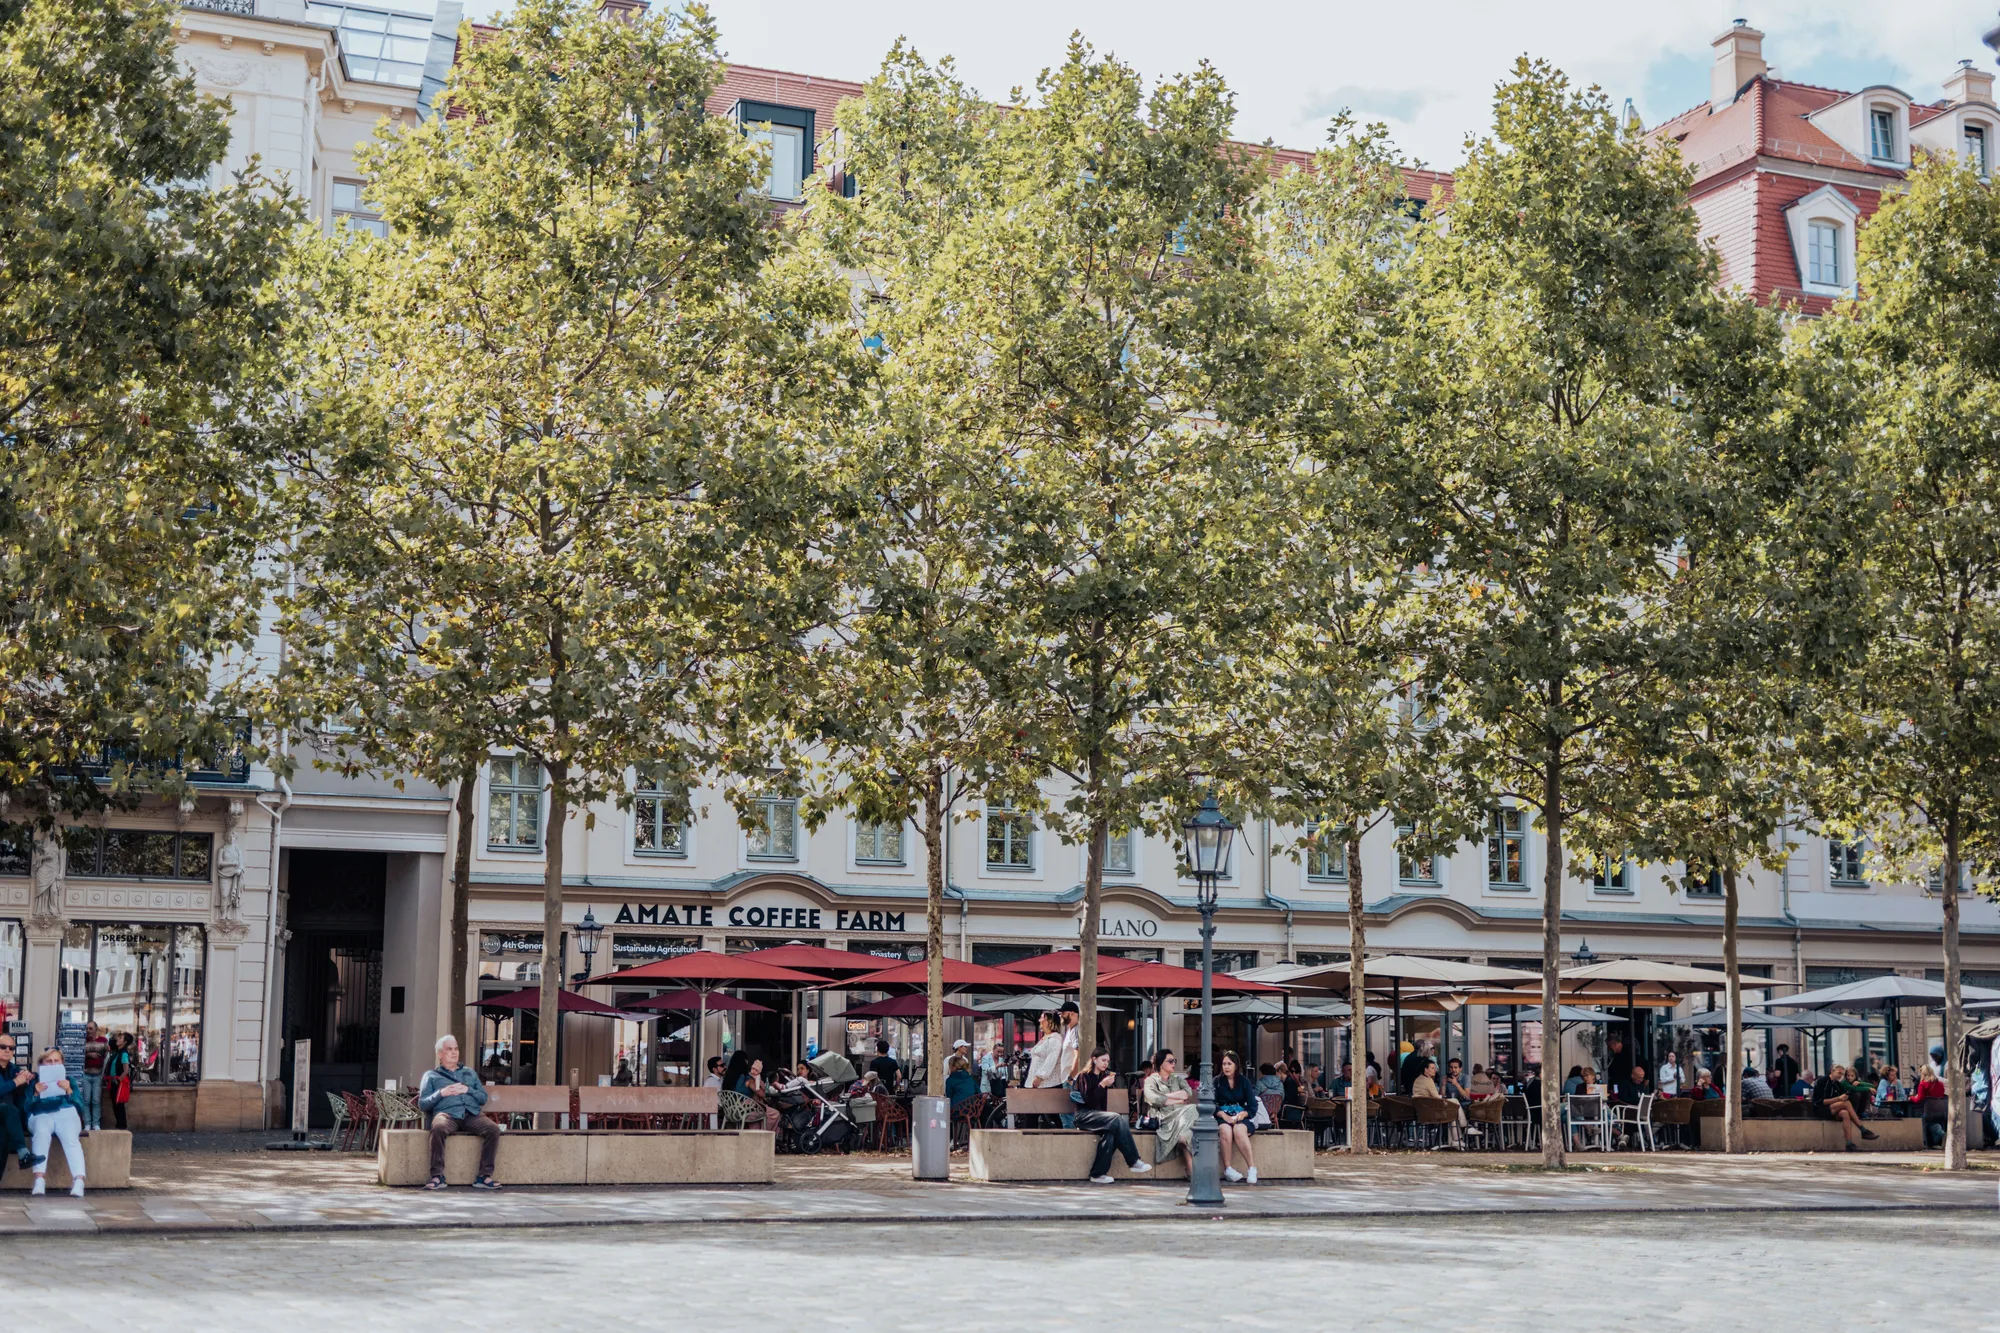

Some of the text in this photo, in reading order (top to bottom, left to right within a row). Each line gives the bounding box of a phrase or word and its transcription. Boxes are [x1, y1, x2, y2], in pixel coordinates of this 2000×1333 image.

[614, 903, 905, 931] AMATE COFFEE FARM
[1077, 917, 1157, 937] LANO
[102, 934, 147, 942] DRESDEN
[502, 941, 517, 949] 4th
[613, 944, 698, 954] Sustainable Agriculture
[870, 950, 902, 960] Roastery
[848, 1022, 866, 1030] OPEN
